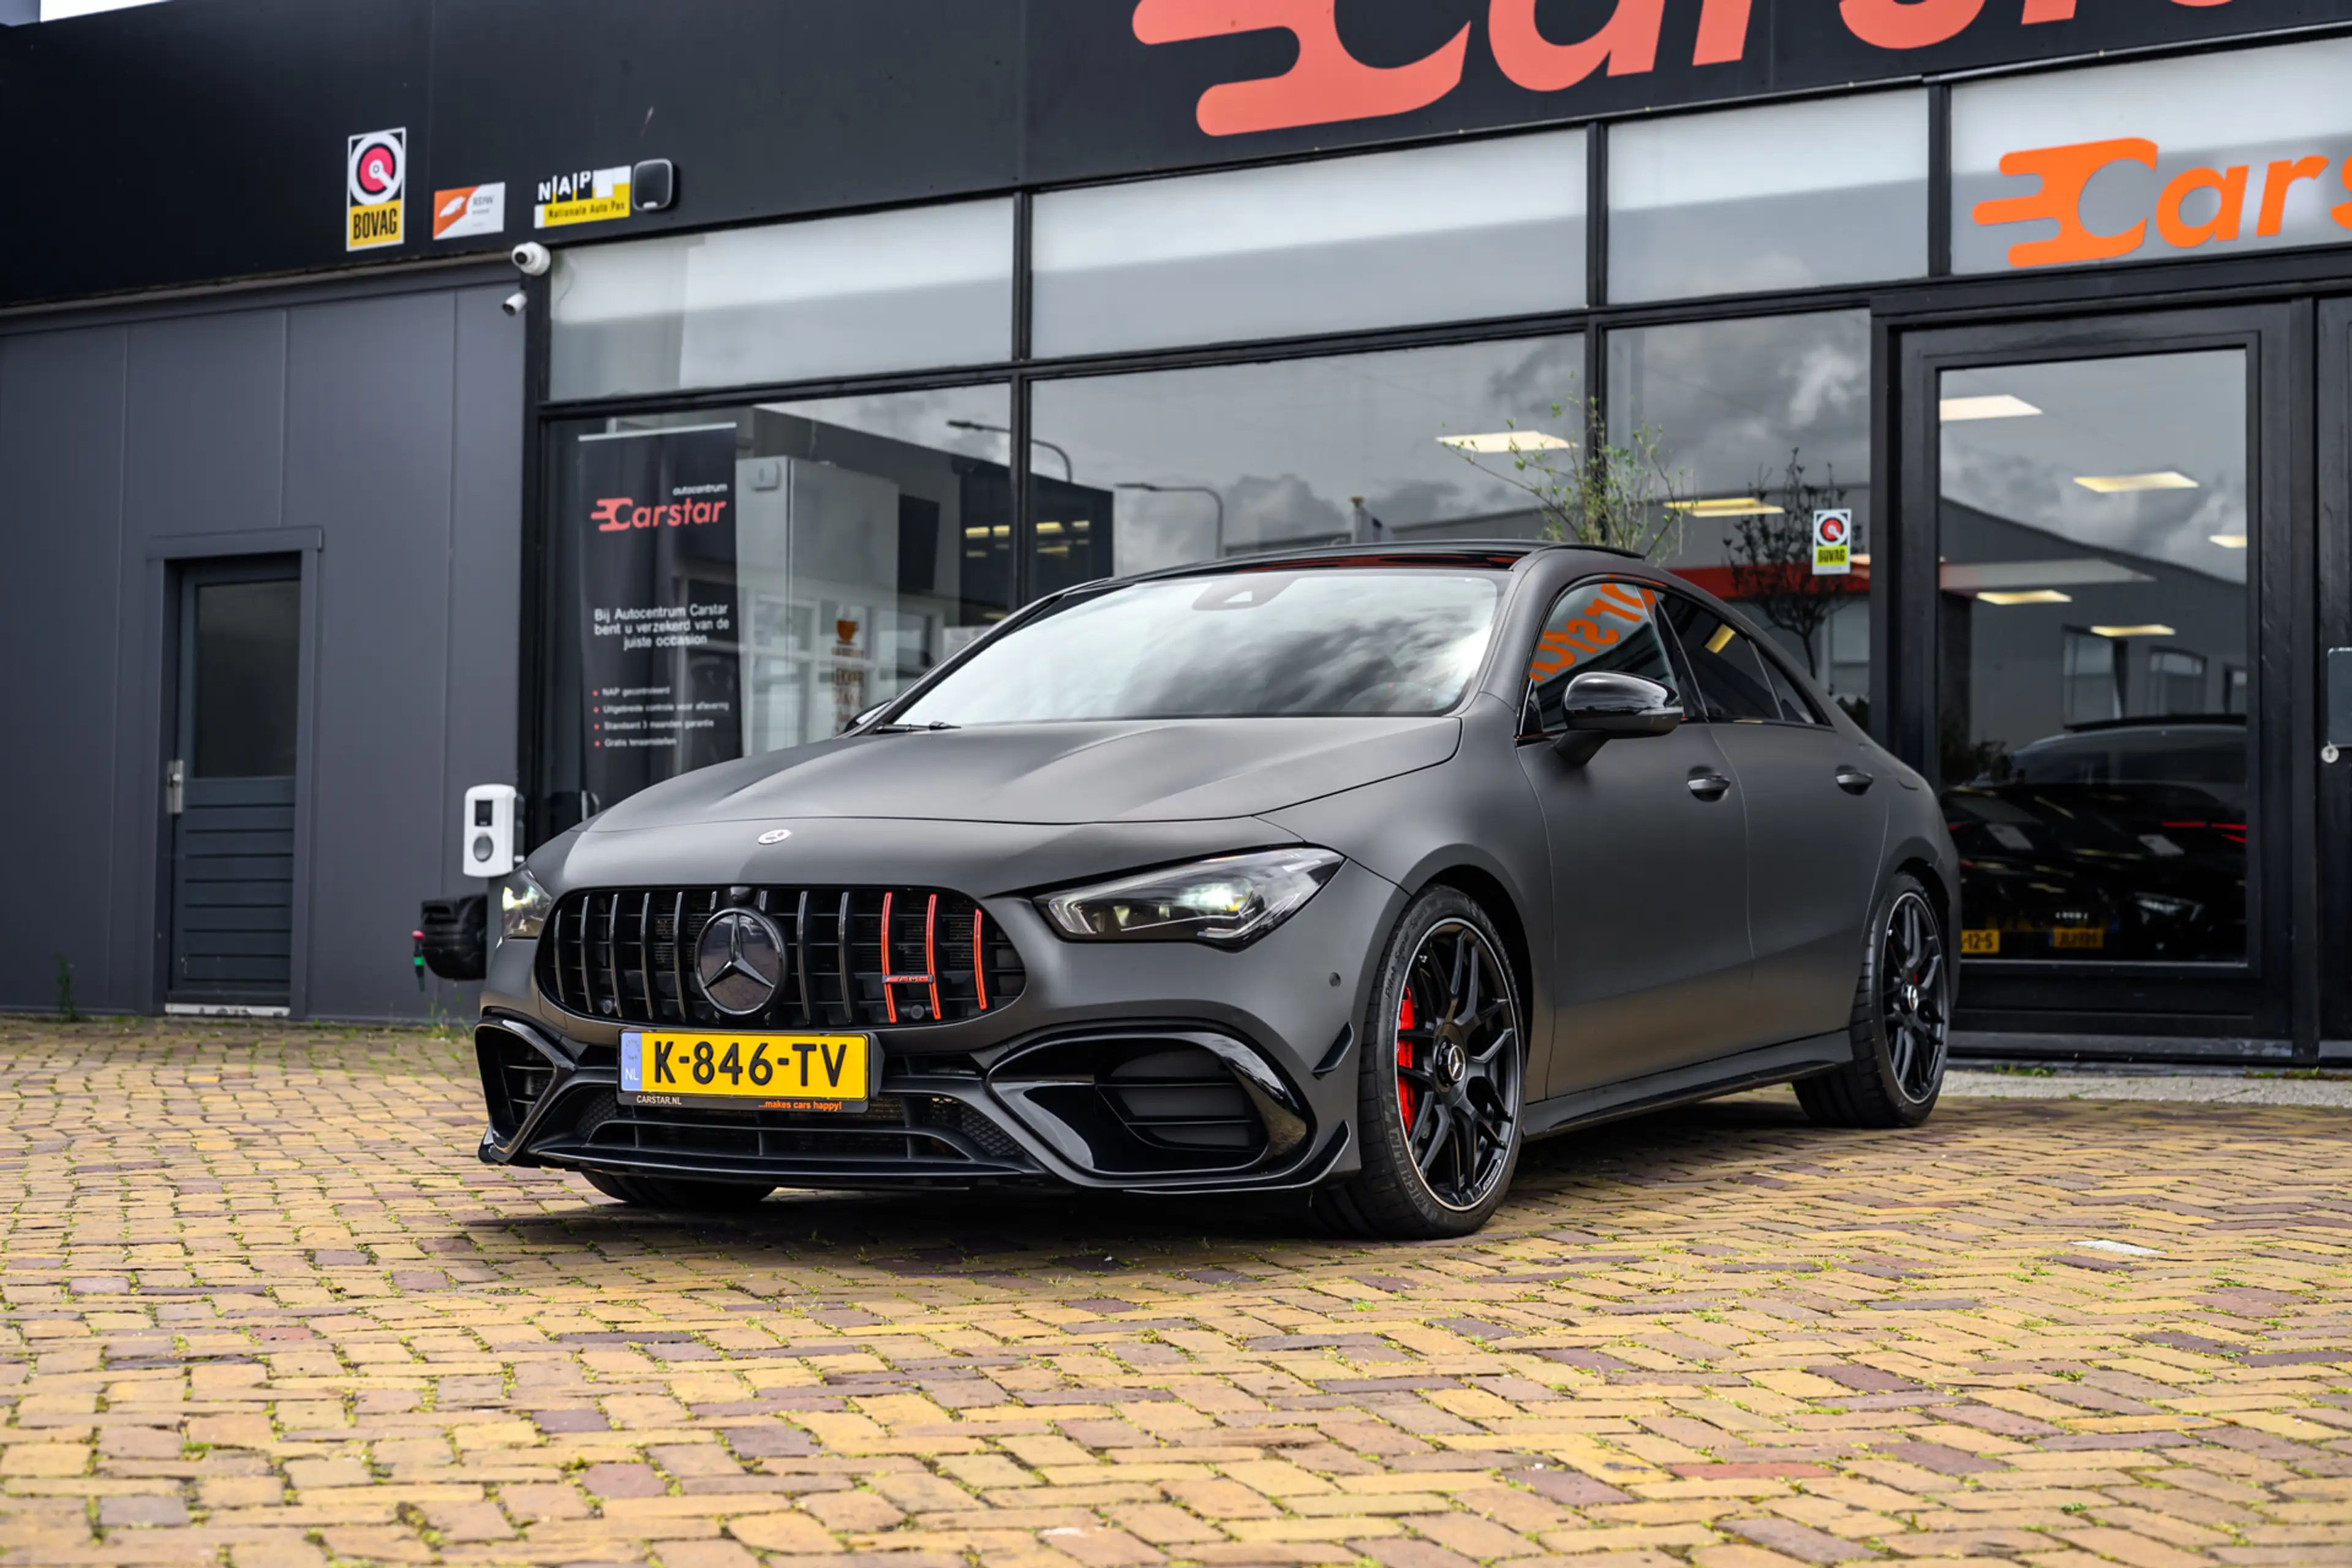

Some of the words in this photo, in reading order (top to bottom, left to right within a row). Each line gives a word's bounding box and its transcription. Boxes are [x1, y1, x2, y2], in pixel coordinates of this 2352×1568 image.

[548, 206, 587, 219] Nationale
[590, 203, 608, 214] Auto
[611, 200, 625, 211] Pas
[353, 208, 398, 239] BOVAG
[590, 497, 726, 532] Carstar
[1818, 549, 1845, 563] BOVAG
[594, 608, 611, 624] Bij
[615, 606, 686, 620] Autocentrum
[690, 603, 728, 617] Carstar
[594, 623, 621, 636] bent
[625, 624, 633, 634] u
[636, 619, 691, 633] verzekerd
[695, 619, 713, 630] van
[716, 617, 730, 630] de
[624, 636, 652, 651] juiste
[655, 633, 708, 647] occasion
[1385, 966, 1398, 1000] Pilot
[655, 1041, 847, 1087] K-846-TV
[625, 1068, 639, 1080] NL
[636, 1095, 682, 1105] CARSTAR.NL
[813, 1101, 843, 1112] happy!
[1388, 1129, 1429, 1211] MICHELIN
